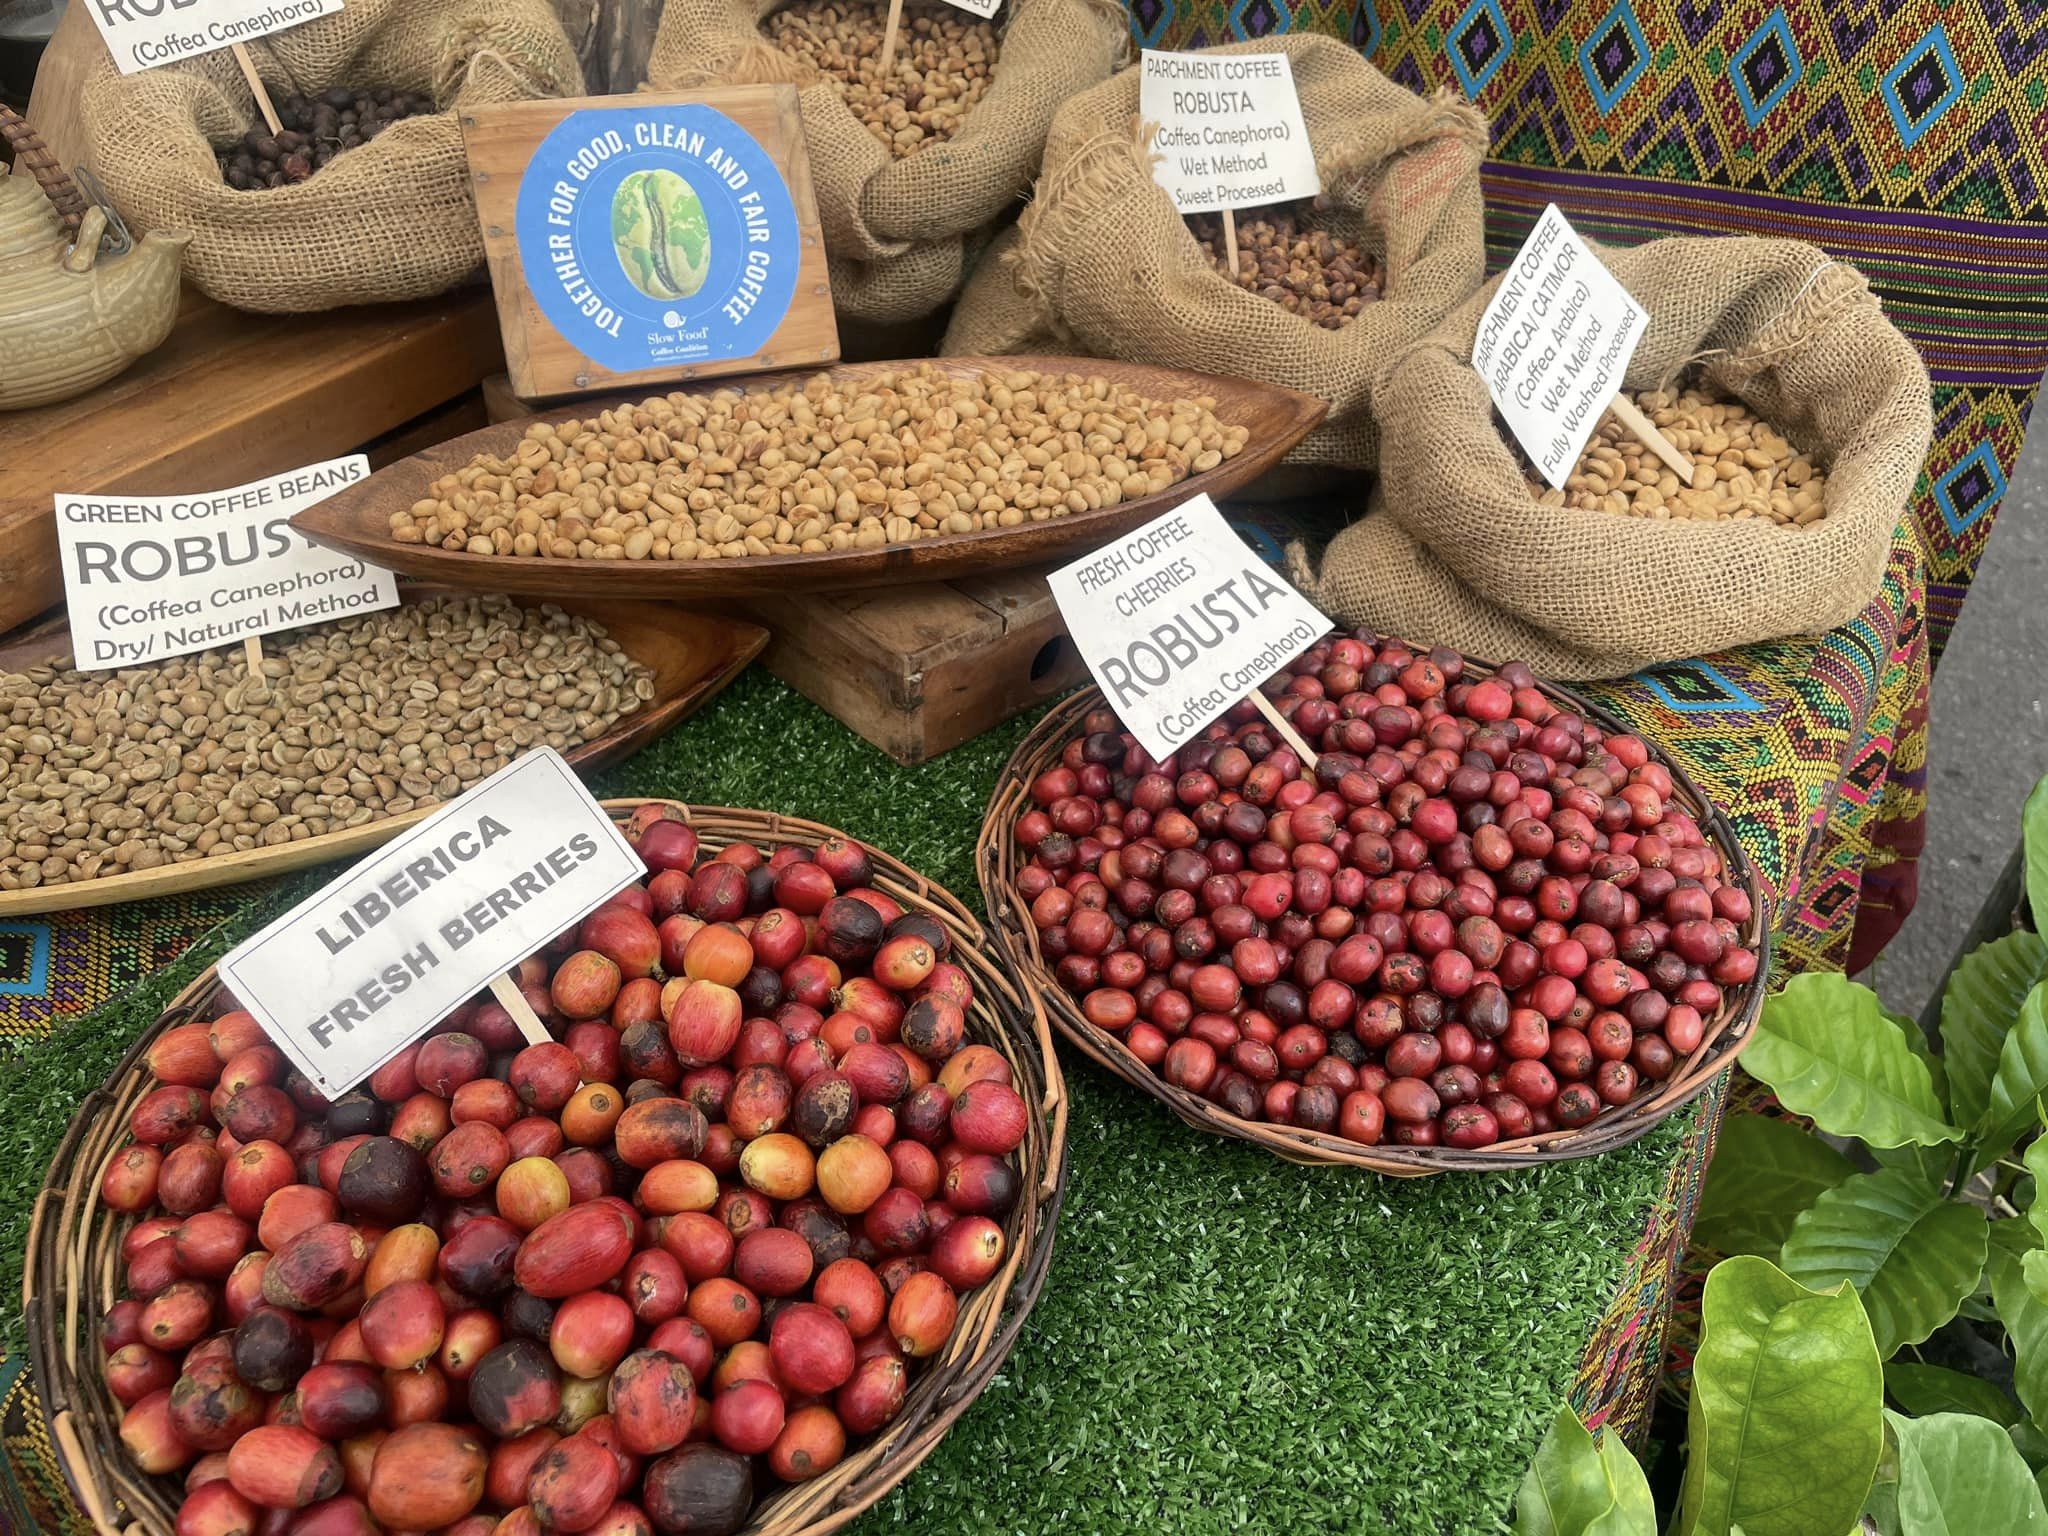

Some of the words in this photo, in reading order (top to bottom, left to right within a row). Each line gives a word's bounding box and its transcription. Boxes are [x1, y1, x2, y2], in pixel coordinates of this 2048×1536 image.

[132, 33, 207, 66] (Coffea
[208, 0, 324, 41] Canephora)
[1147, 58, 1221, 80] PARCHMENT
[1224, 60, 1281, 80] COFFEE
[1173, 91, 1255, 114] ROBUSTA
[567, 129, 631, 181] GOOD,
[635, 122, 705, 157] CLEAN
[1154, 126, 1200, 149] (Coffea
[1203, 120, 1290, 147] Canephora)
[1180, 157, 1208, 176] Wet
[1211, 152, 1268, 175] Method
[705, 147, 748, 191] AND
[1176, 187, 1214, 206] Sweet
[1217, 177, 1285, 202] Processed
[547, 180, 579, 227] FOR
[738, 191, 770, 243] FAIR
[548, 234, 624, 338] TOGETHER
[722, 250, 770, 326] COFFEE
[1477, 273, 1527, 375] PARCHMENT
[1521, 216, 1561, 280] COFFEE
[648, 332, 674, 345] Slow
[1493, 311, 1541, 399] ARABICA/
[1533, 241, 1578, 317] CATIMOR
[1515, 345, 1557, 409] (Coffea
[1556, 279, 1591, 348] Arabica)
[1541, 375, 1572, 415] Wet
[1571, 314, 1602, 380] Method
[1543, 432, 1572, 474] Fully
[1562, 370, 1609, 432] Washed
[1600, 305, 1638, 374] Processed
[64, 502, 163, 524] GREEN
[171, 487, 273, 521] COFFEE
[279, 462, 361, 500] BEANS
[75, 518, 317, 585] ROBUS
[1076, 550, 1131, 595] FRESH
[1126, 516, 1193, 565] COFFEE
[98, 600, 202, 630] (Coffea
[210, 559, 366, 609] Canephora)
[1115, 557, 1197, 617] CHERRIES
[93, 634, 154, 662] Dry/
[165, 608, 269, 650] Natural
[278, 585, 379, 624] Method
[1099, 567, 1288, 710] ROBUSTA
[1157, 689, 1226, 745] (Coffea
[1220, 618, 1317, 692] Canephora)
[314, 814, 512, 956] LIBERICA
[307, 941, 441, 1049] FRESH
[438, 832, 599, 952] BERRIES
